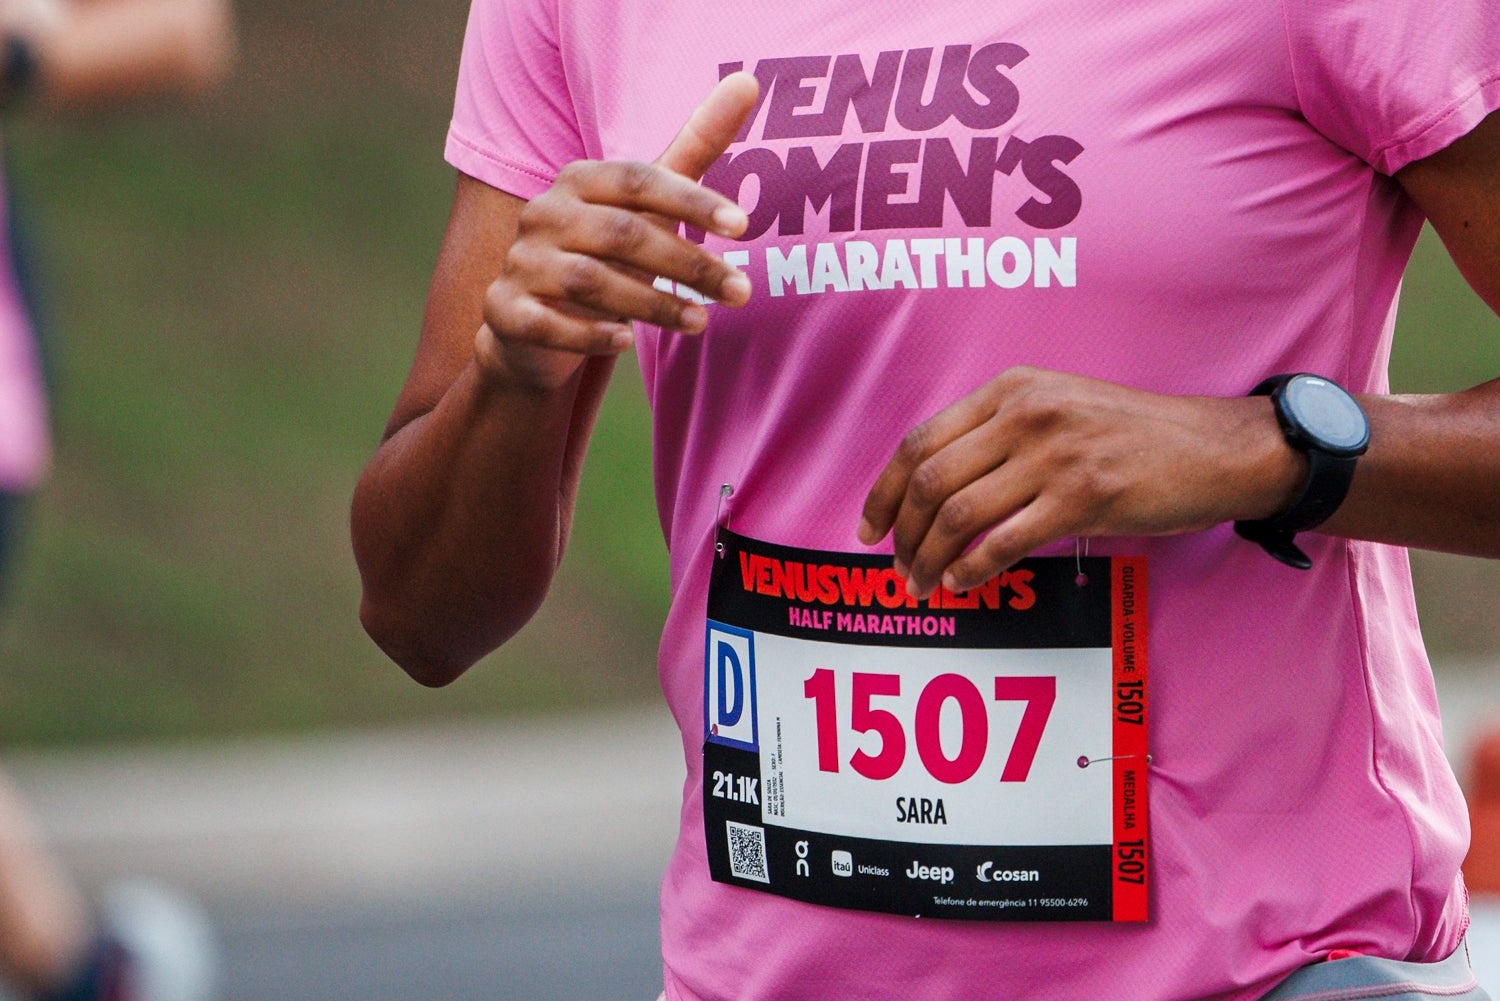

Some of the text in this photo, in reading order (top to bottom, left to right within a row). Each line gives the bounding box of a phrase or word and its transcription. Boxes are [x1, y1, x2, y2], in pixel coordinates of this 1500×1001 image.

[766, 236, 1077, 297] MARATHON
[788, 606, 956, 637] HALF MARATHON
[1117, 566, 1144, 726] GUARDA-VOLUME 1507
[717, 640, 744, 727] D
[804, 668, 1056, 784] 1507
[712, 770, 759, 805] 21.1K
[896, 796, 947, 825] SARA
[1117, 770, 1144, 885] MEDALHA 1507
[858, 864, 889, 877] Uniclass
[906, 861, 954, 884] Jeep
[993, 868, 1039, 882] cosan
[933, 896, 1088, 909] Telefone de emergência 11 95500-6296
